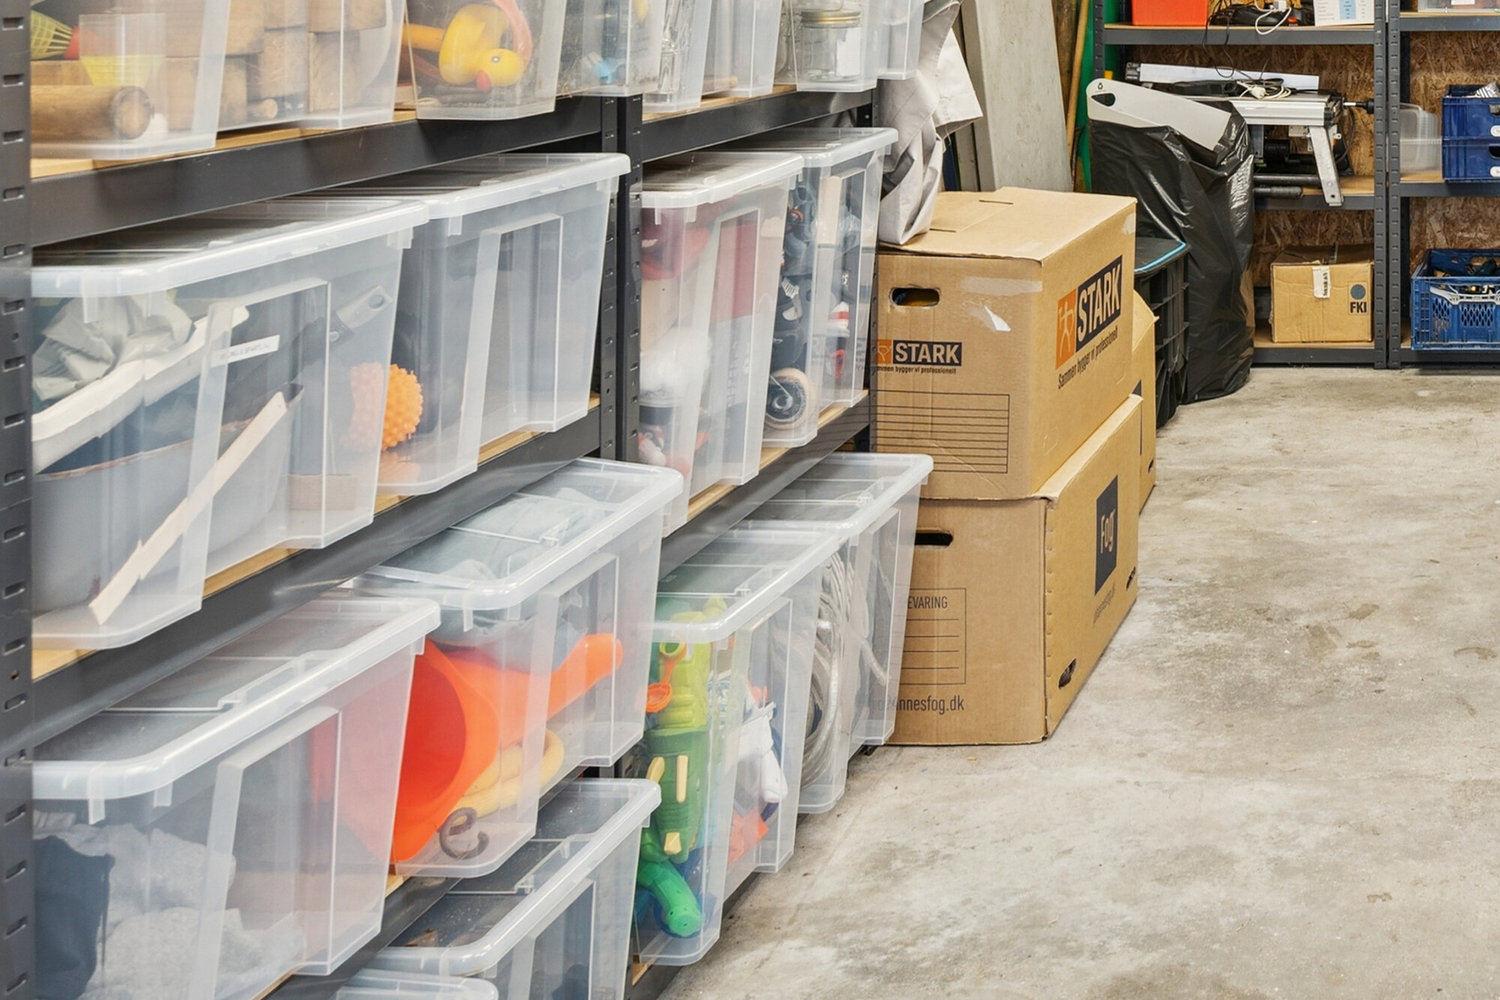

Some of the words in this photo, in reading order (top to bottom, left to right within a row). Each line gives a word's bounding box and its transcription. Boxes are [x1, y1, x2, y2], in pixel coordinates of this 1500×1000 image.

[1077, 263, 1121, 343] STARK
[1350, 301, 1367, 314] FKI
[895, 342, 960, 364] STARK
[907, 596, 948, 609] EVARING
[896, 695, 965, 716] nnesfog.dk
